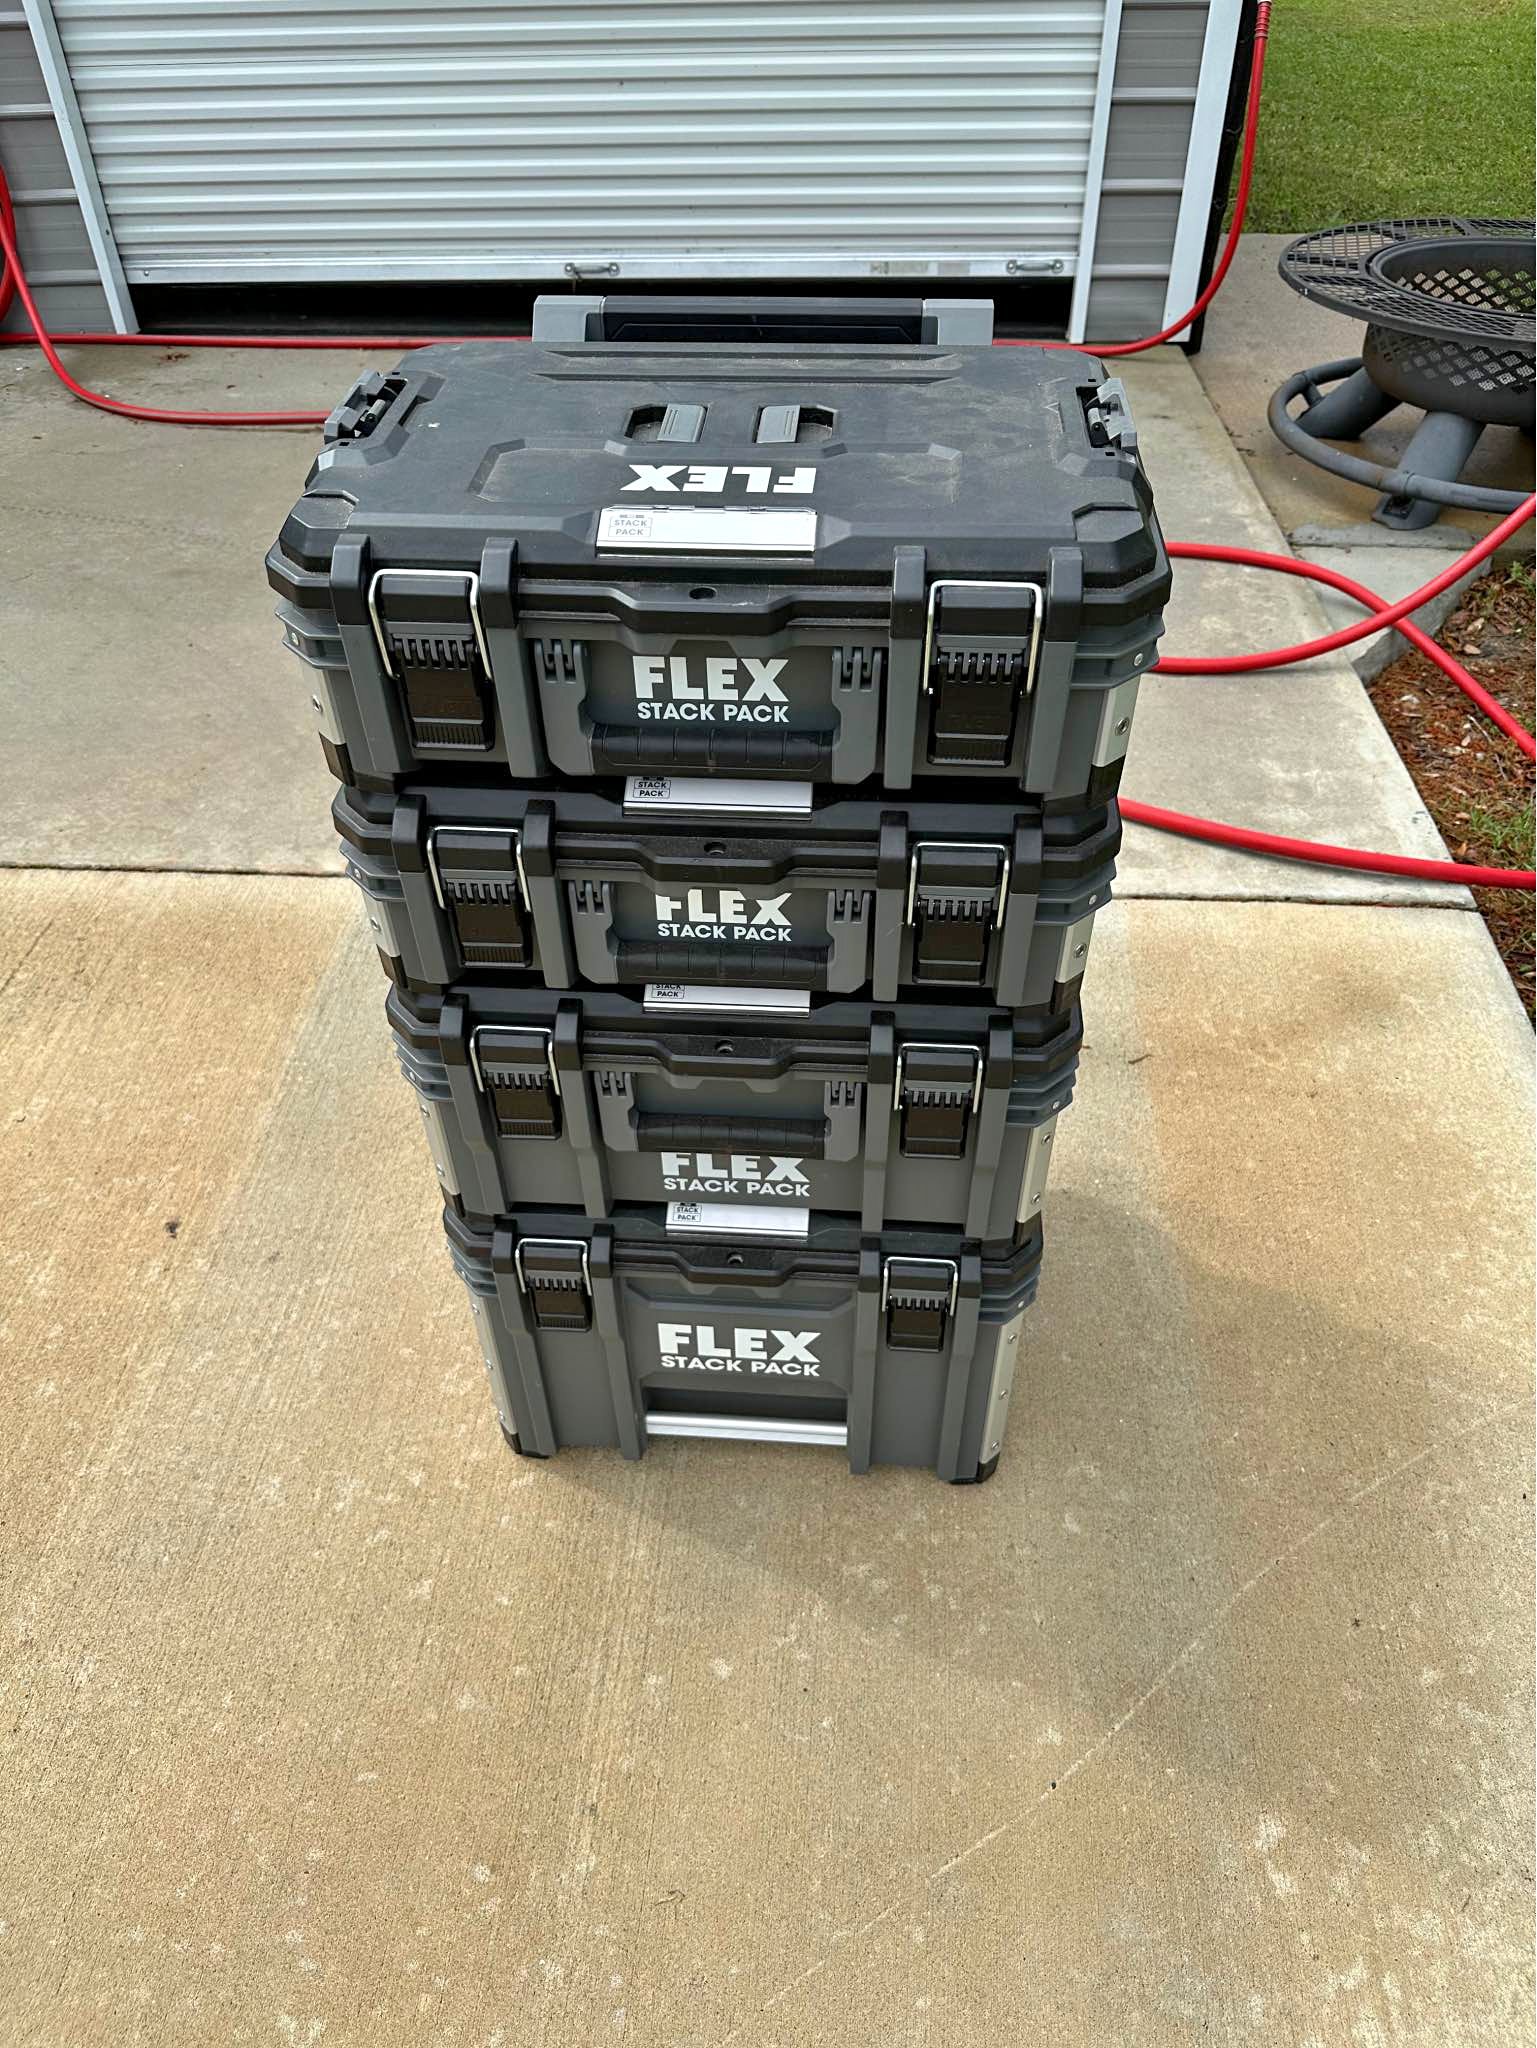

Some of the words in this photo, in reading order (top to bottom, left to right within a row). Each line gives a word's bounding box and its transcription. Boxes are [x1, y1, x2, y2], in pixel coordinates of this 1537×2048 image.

[620, 465, 816, 493] FLEX
[614, 519, 648, 527] STACK
[615, 528, 644, 536] PACK
[633, 656, 789, 702] FLEX
[637, 702, 716, 721] STACK
[724, 704, 789, 723] PACK
[639, 789, 664, 797] PACK
[655, 889, 792, 926] FLEX
[657, 923, 726, 939] STACK
[734, 926, 792, 942] PACK
[660, 1152, 810, 1182] FLEX
[663, 1177, 739, 1193] STACK
[747, 1181, 811, 1197] PACK
[657, 1322, 821, 1363] FLEX
[661, 1354, 742, 1372] STACK
[751, 1361, 821, 1377] PACK
